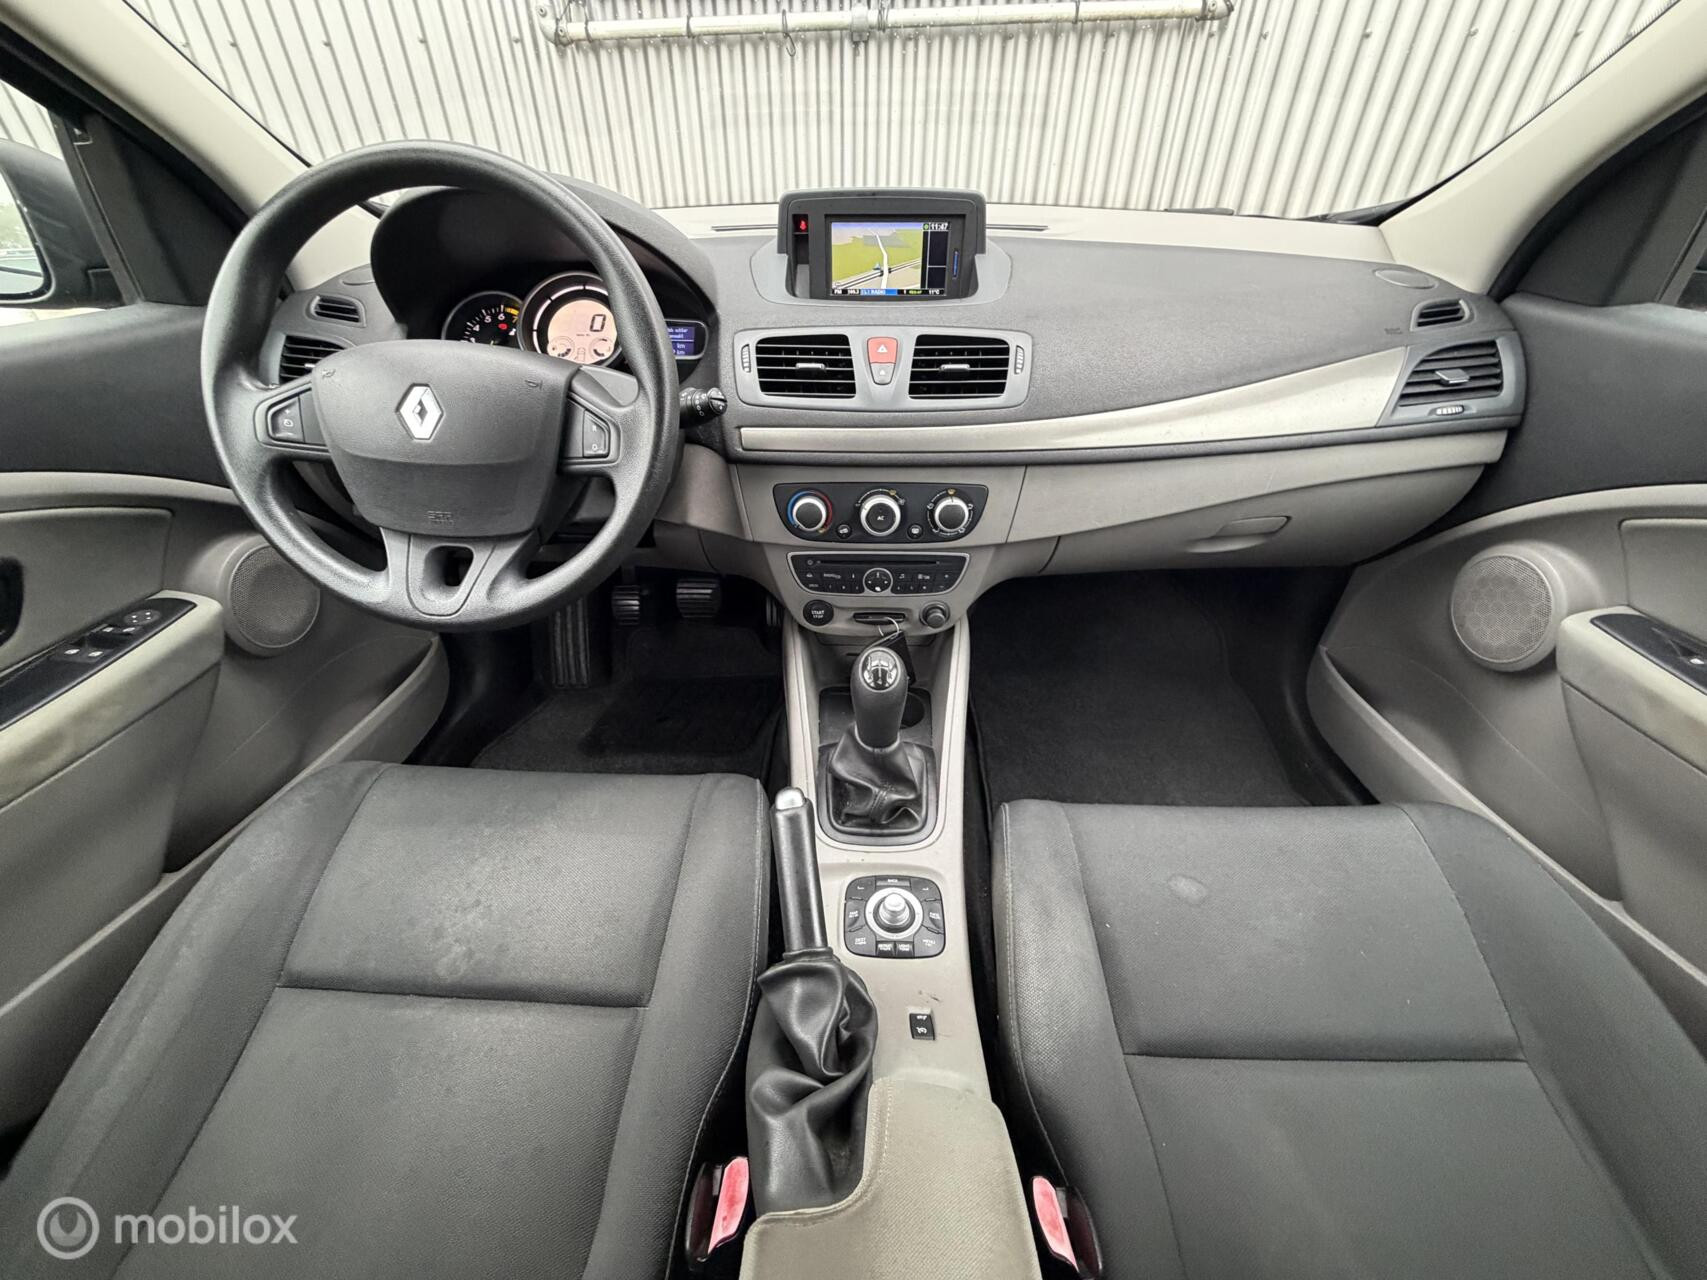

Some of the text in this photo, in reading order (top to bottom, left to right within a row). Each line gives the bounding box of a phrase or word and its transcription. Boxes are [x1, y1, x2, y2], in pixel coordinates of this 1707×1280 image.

[484, 315, 492, 323] 5
[497, 313, 505, 321] 6
[589, 313, 606, 332] 0
[473, 324, 480, 332] 4
